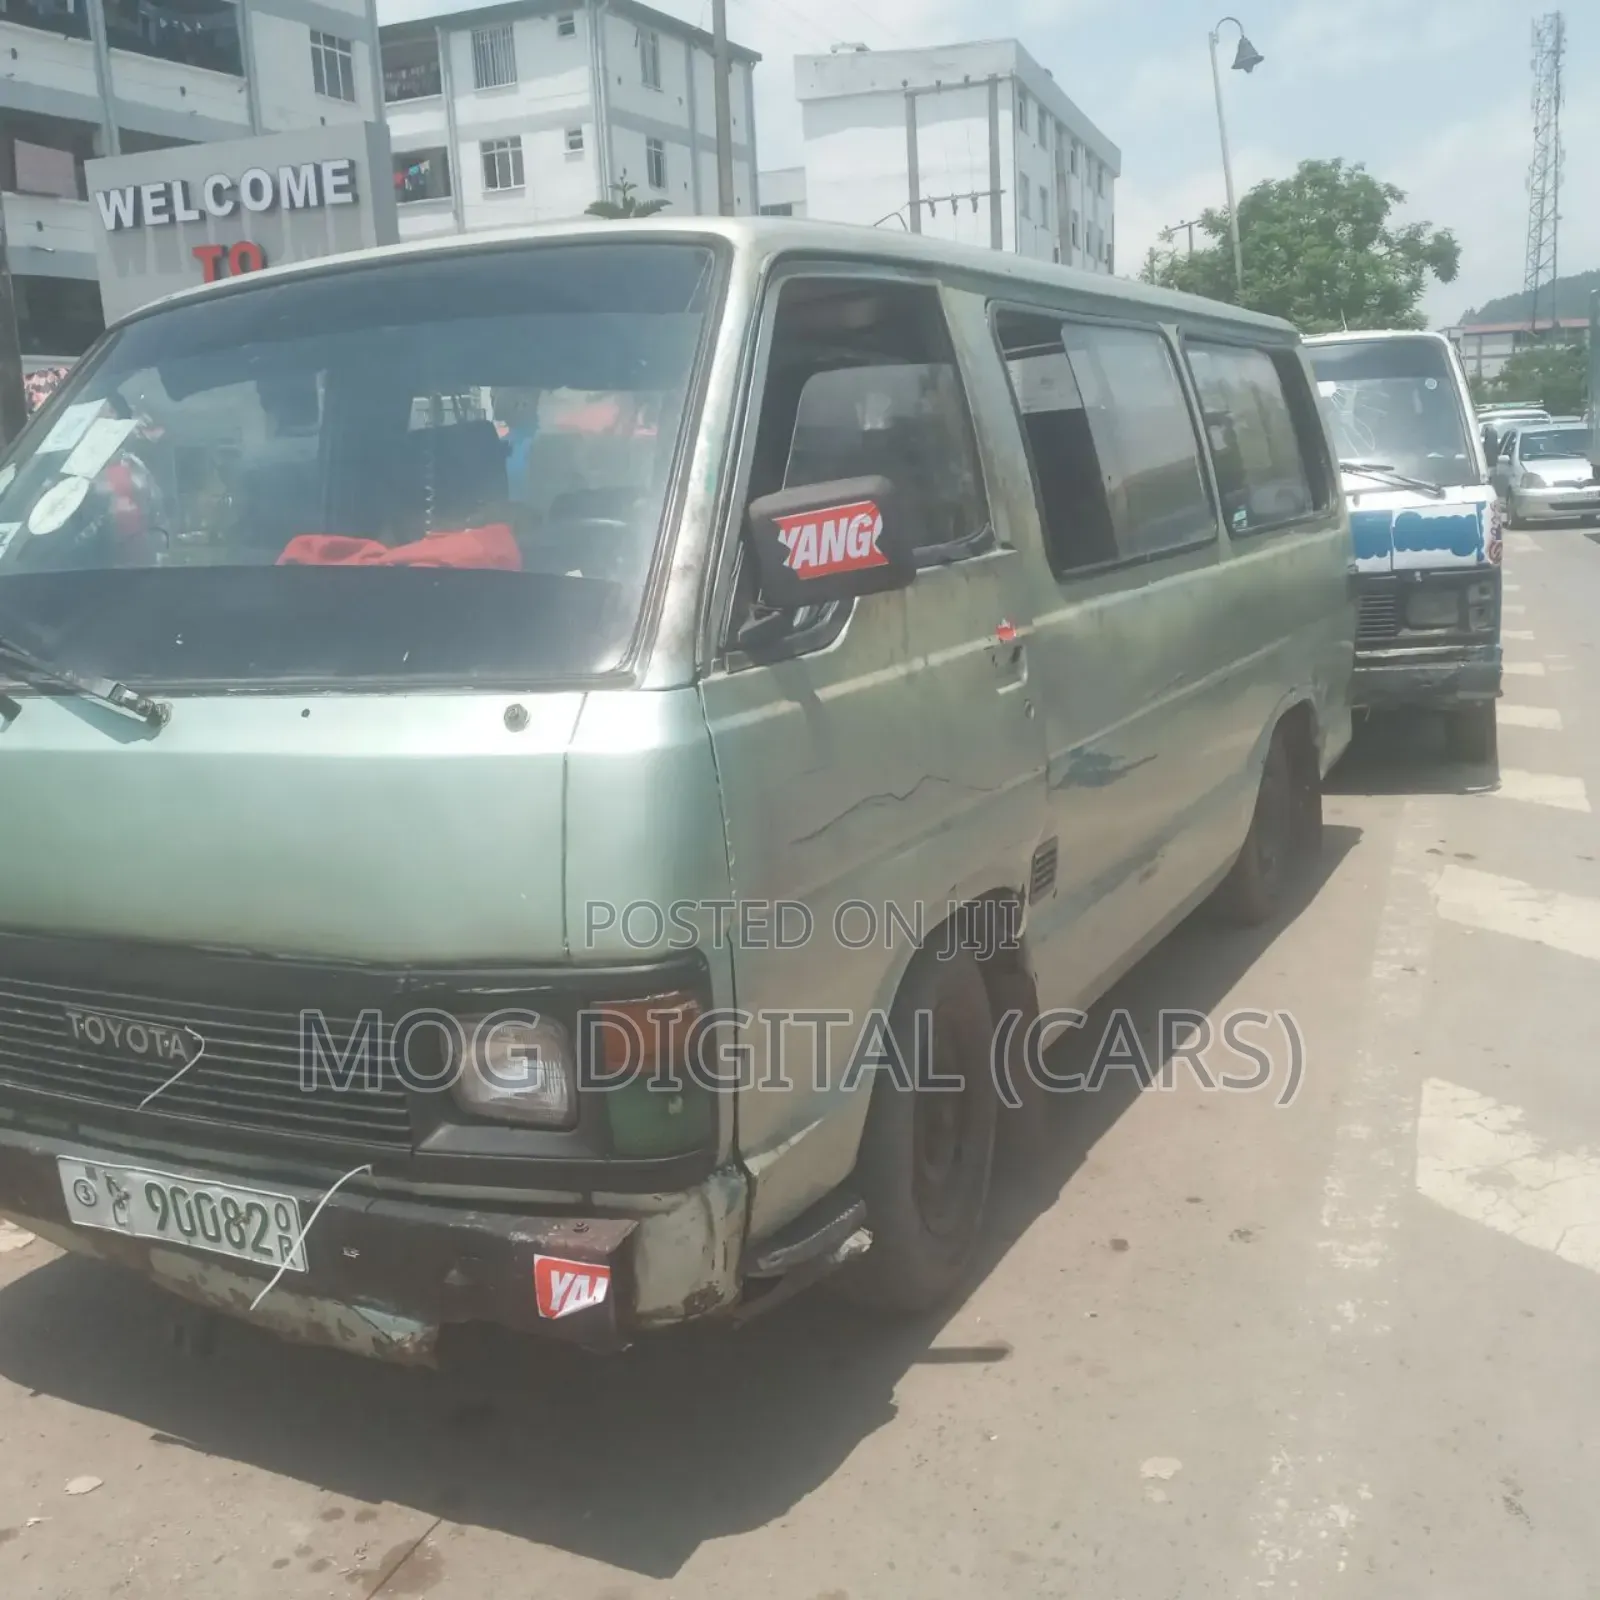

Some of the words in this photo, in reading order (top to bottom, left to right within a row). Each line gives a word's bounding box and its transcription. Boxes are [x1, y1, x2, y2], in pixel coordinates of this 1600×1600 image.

[96, 159, 356, 232] WELCOME
[192, 241, 263, 284] TO
[66, 1011, 189, 1062] TOYOTA
[144, 1181, 274, 1257] 90082
